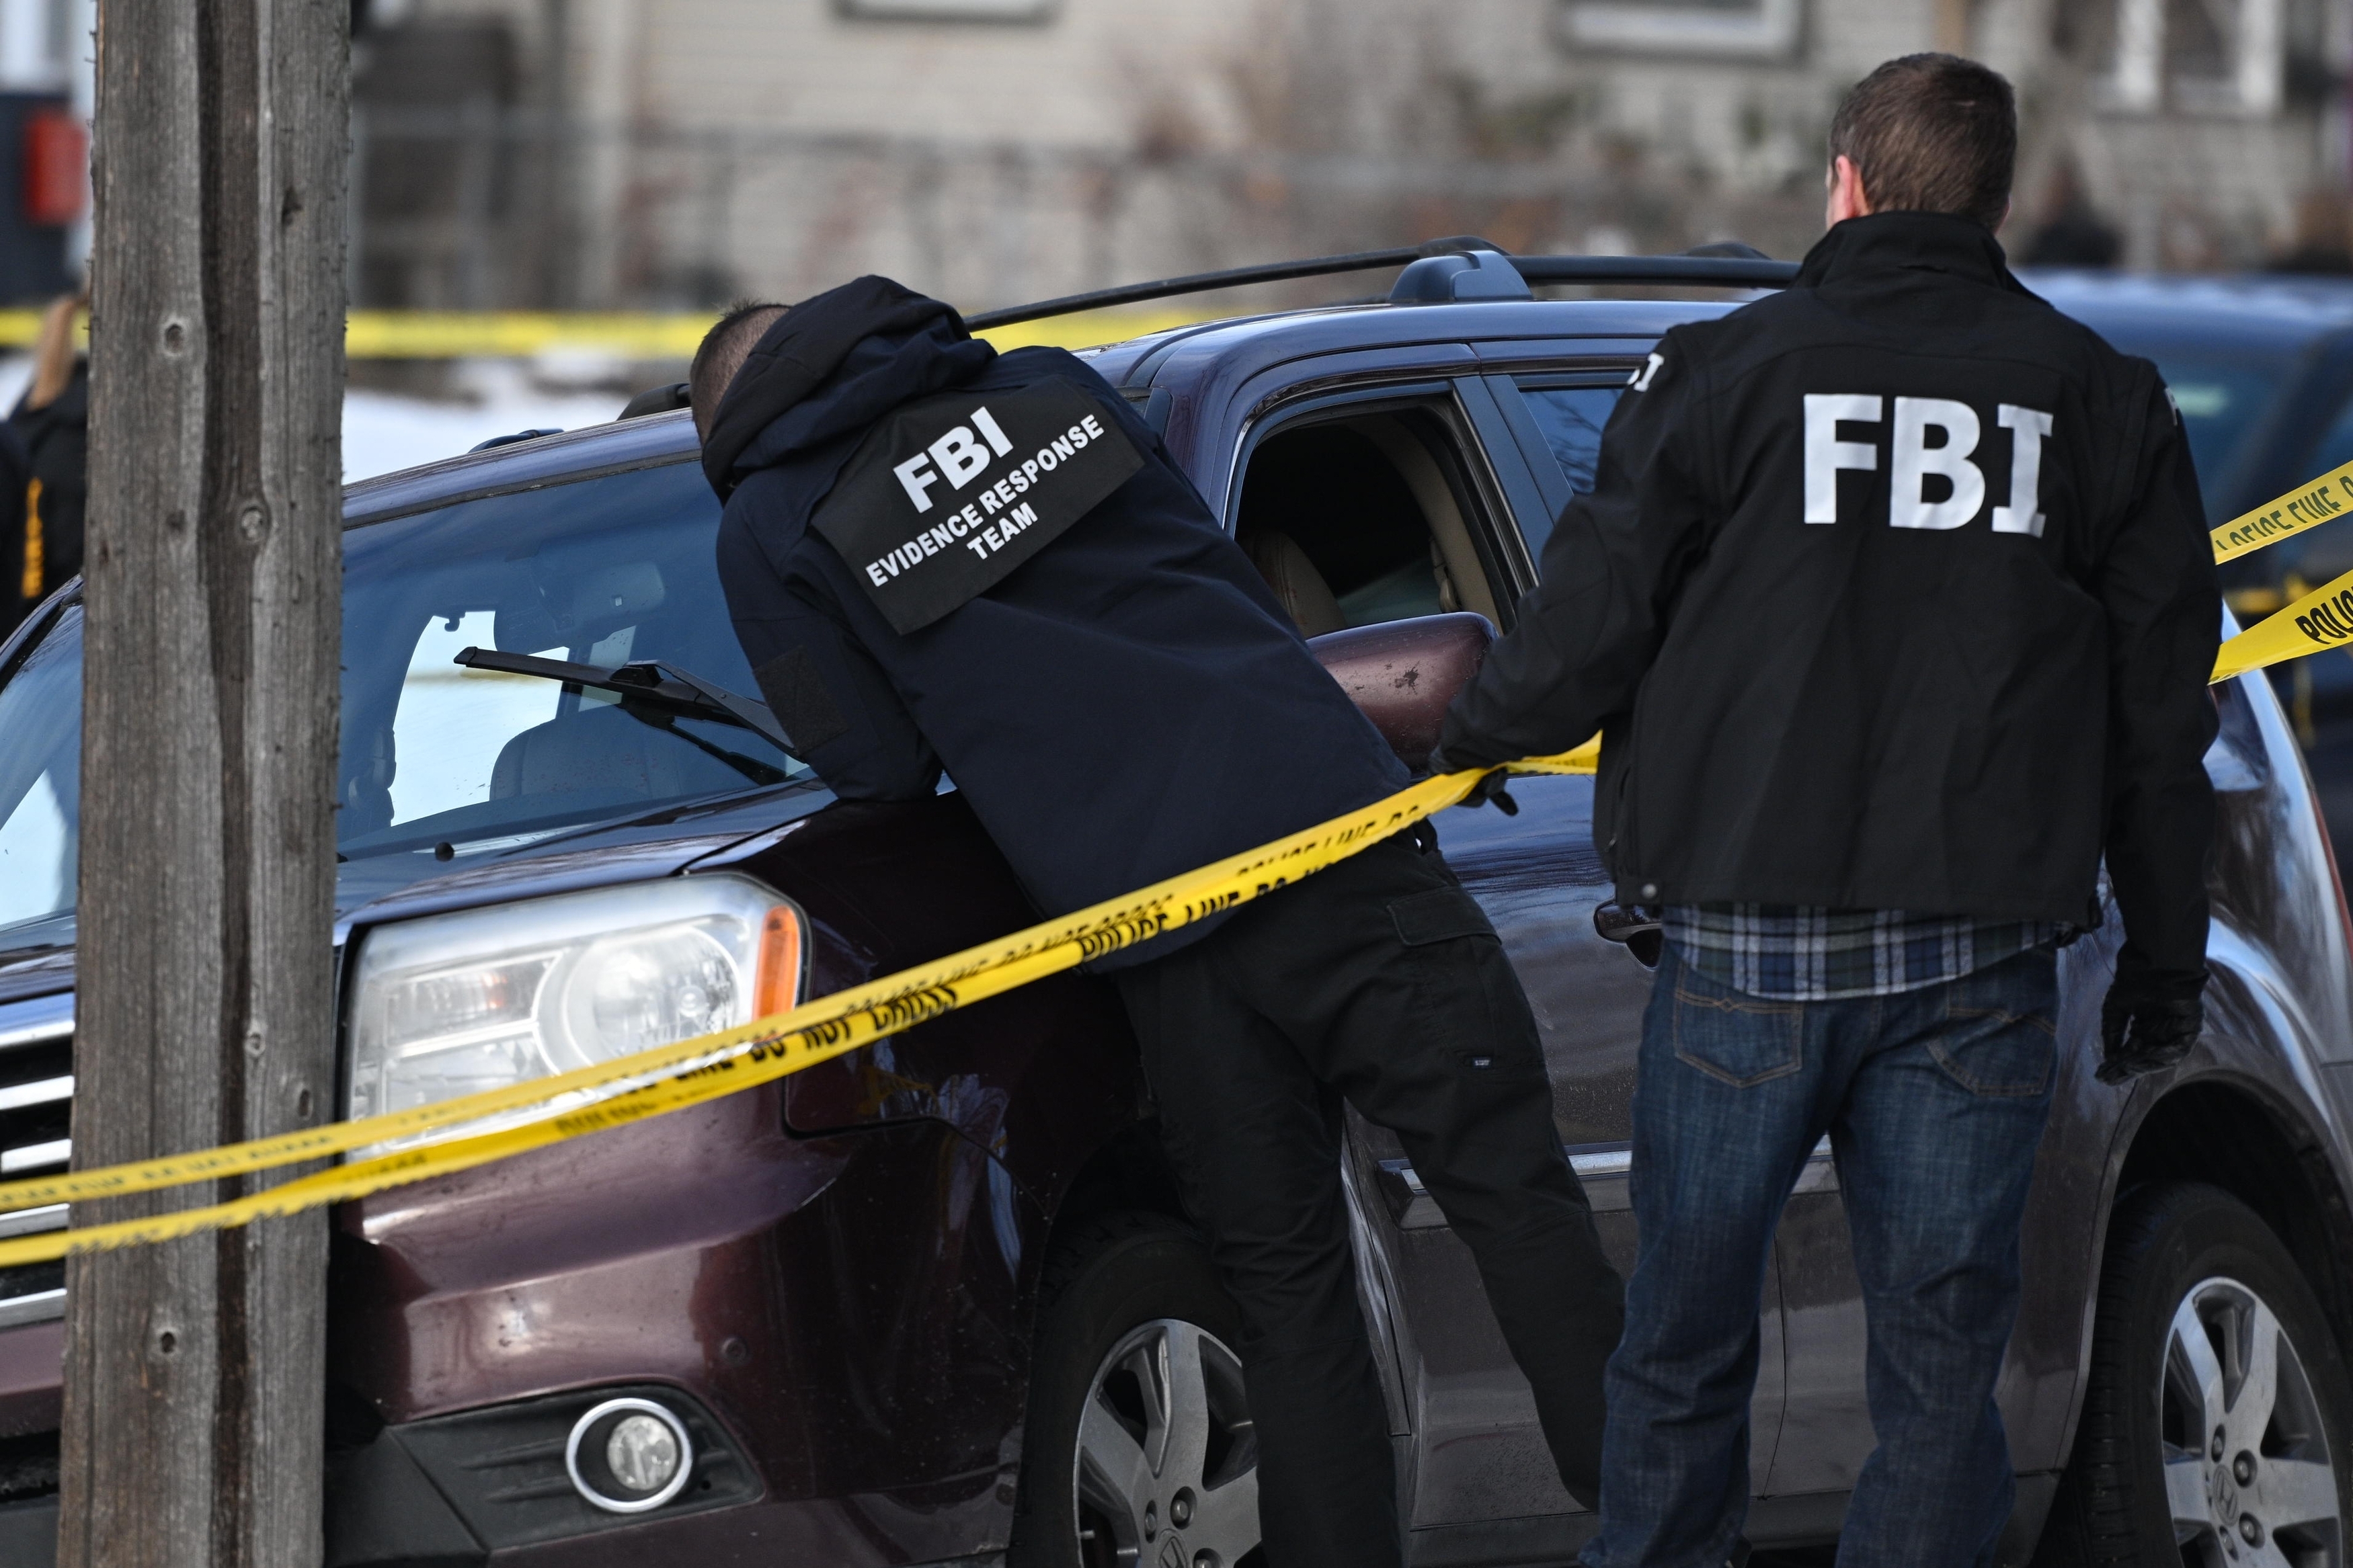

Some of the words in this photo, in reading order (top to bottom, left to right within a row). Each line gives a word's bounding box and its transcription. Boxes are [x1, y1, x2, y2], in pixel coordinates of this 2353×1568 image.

[865, 503, 984, 587] EVIDENCE
[978, 413, 1105, 515] RESPONSE
[893, 405, 1014, 513] FBI
[1803, 393, 2054, 538] FBI
[966, 501, 1038, 560] TEAM
[2295, 585, 2353, 645] POLIC
